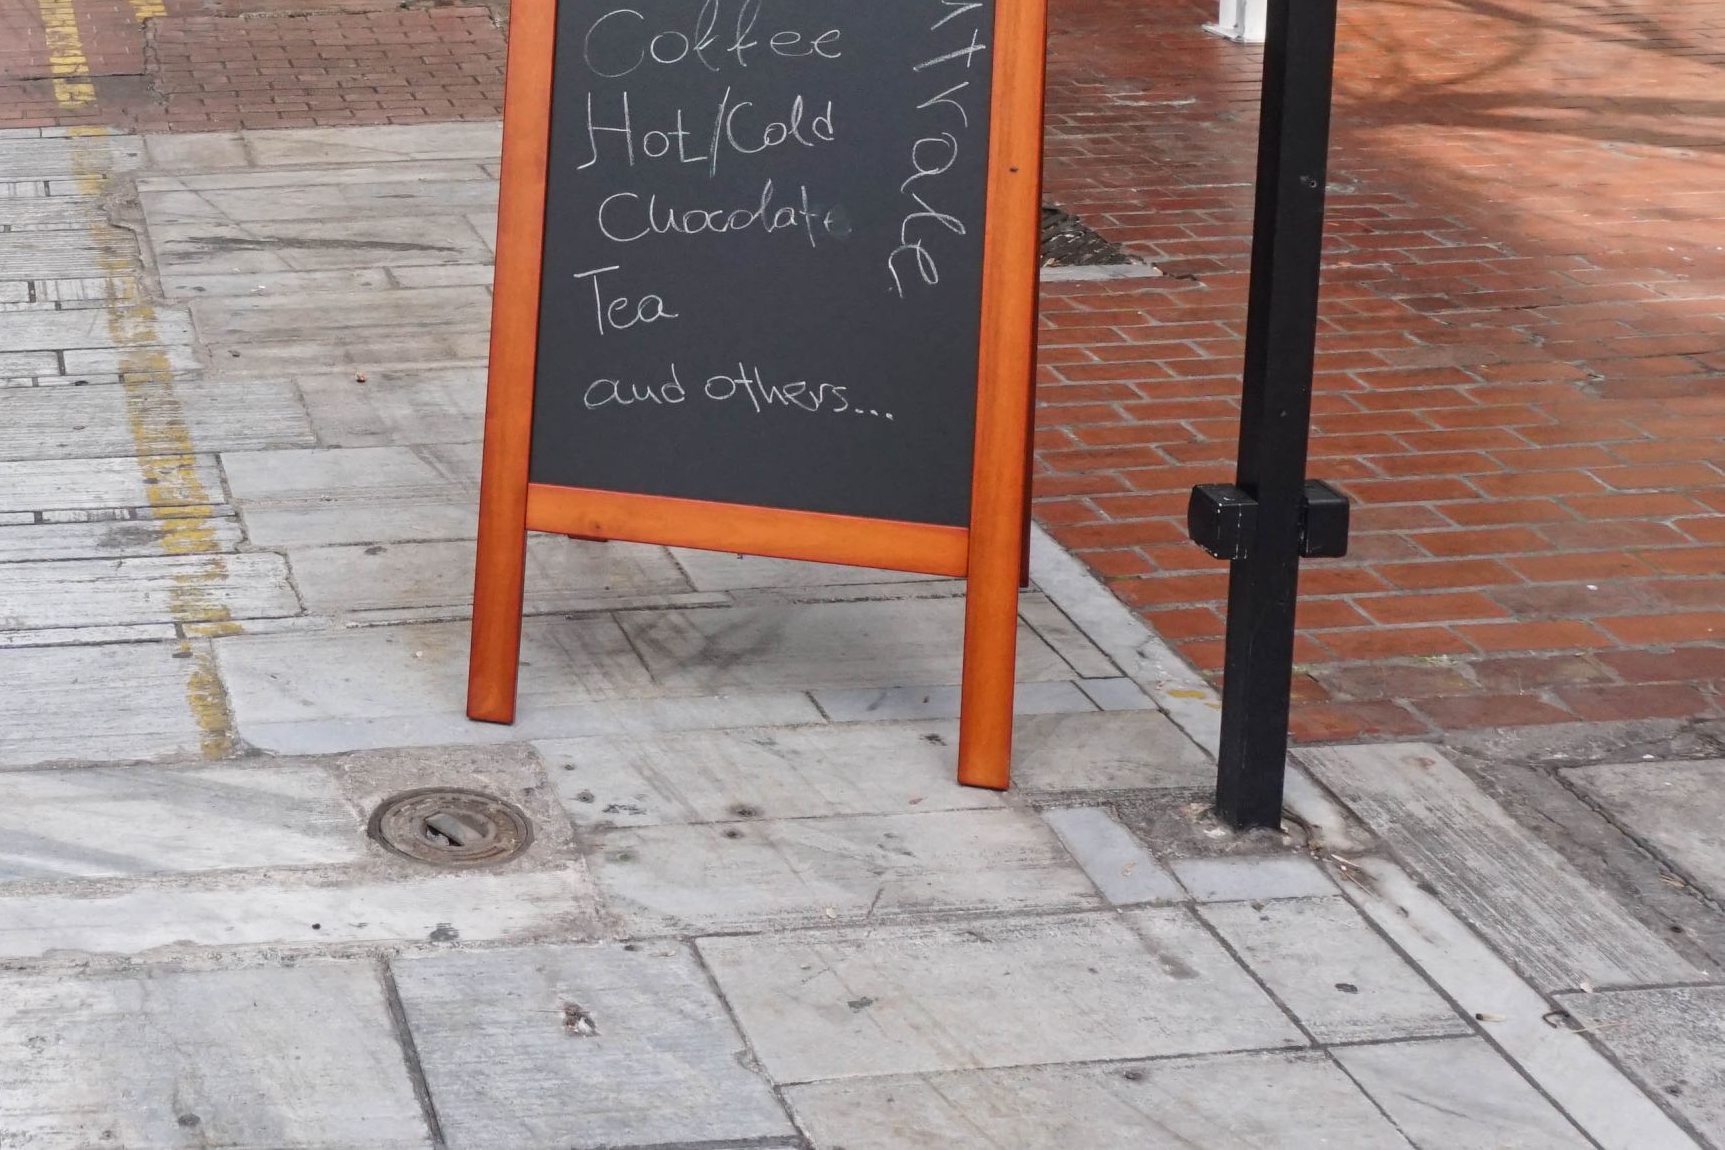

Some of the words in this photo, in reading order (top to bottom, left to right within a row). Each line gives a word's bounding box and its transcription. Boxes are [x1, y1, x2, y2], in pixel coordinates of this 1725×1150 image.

[576, 84, 835, 178] Hot/Cold
[597, 178, 853, 248] Chocolate
[572, 264, 679, 335] Tea
[582, 367, 686, 410] and
